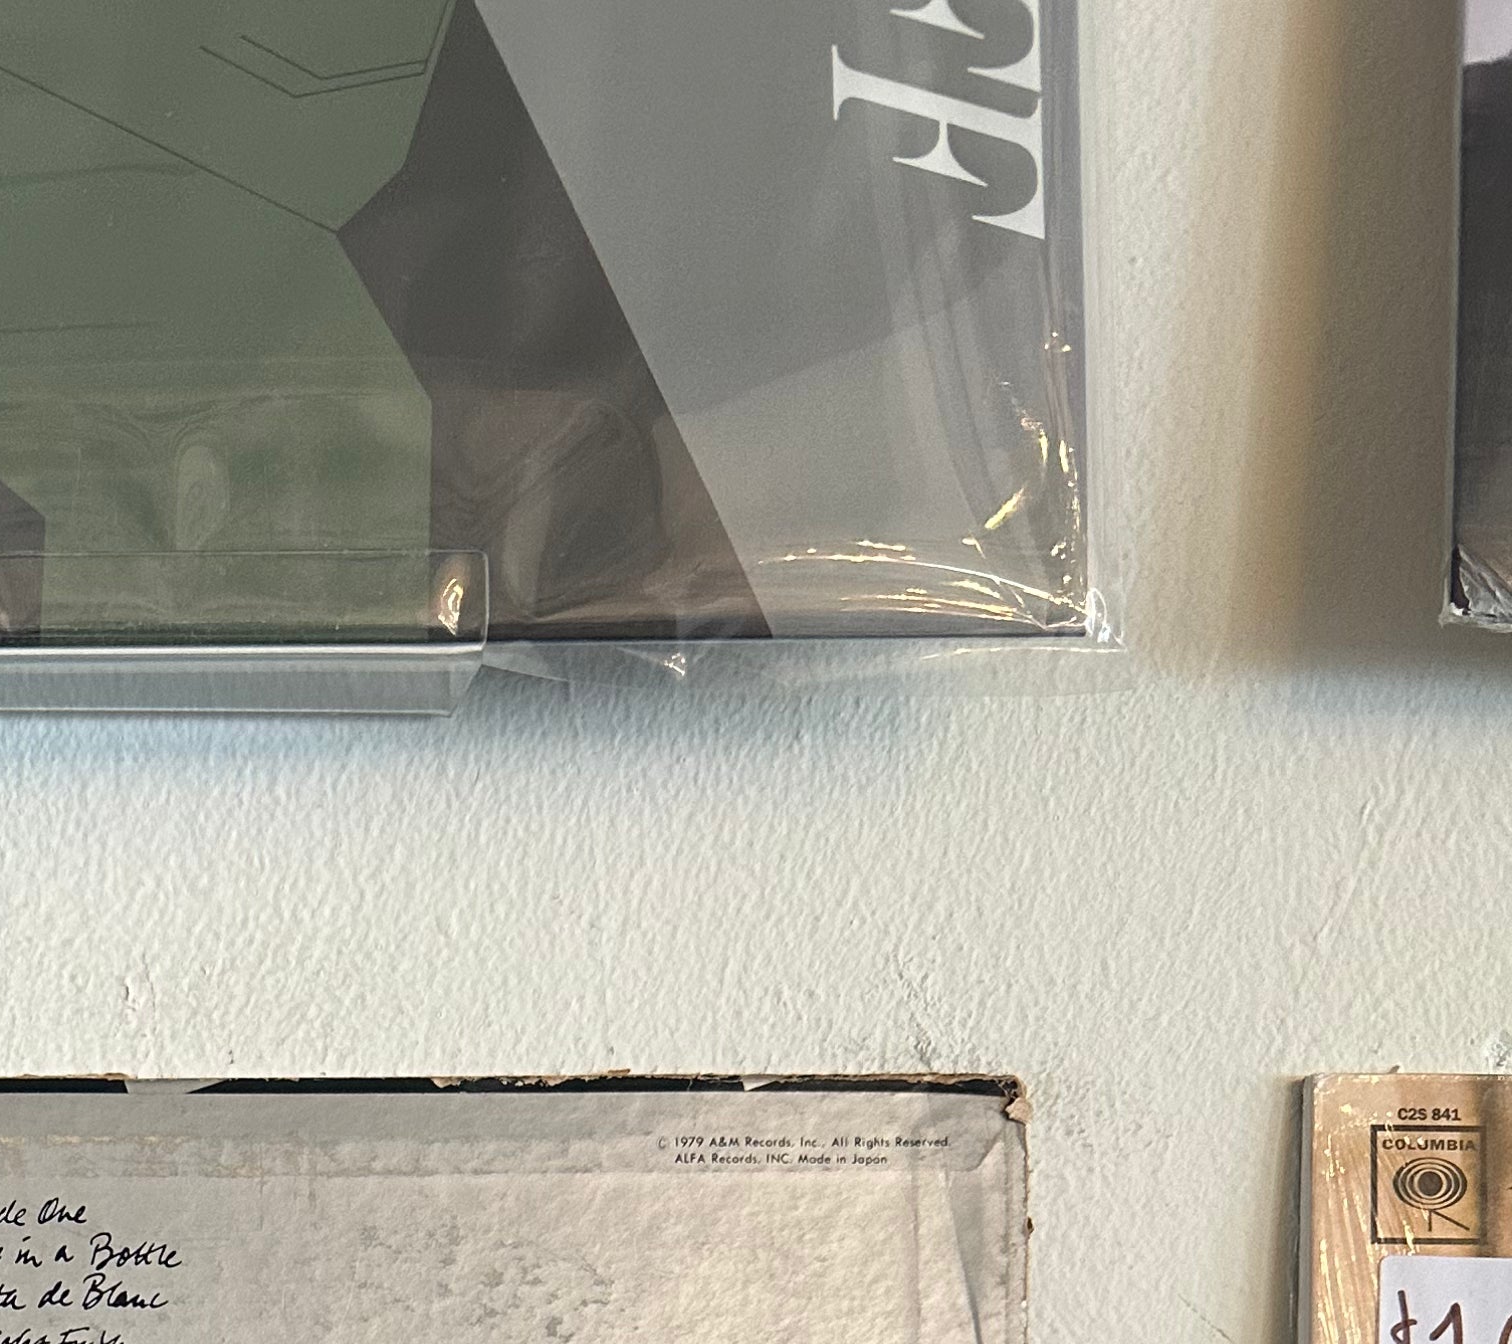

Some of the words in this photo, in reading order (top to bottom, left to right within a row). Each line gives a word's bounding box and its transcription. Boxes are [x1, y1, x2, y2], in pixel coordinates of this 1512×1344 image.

[1397, 1107, 1428, 1122] C2S
[1431, 1107, 1462, 1122] 841
[674, 1136, 704, 1148] 1979
[708, 1136, 739, 1148] A&M
[831, 1136, 849, 1148] All
[854, 1136, 890, 1150] Rights
[1381, 1138, 1477, 1152] COLUMBIA
[674, 1153, 705, 1164] ALFA
[798, 1153, 831, 1164] Made
[836, 1154, 847, 1164] in
[851, 1153, 888, 1166] Japan
[37, 1197, 88, 1225] One
[14, 1235, 43, 1268] in
[54, 1245, 75, 1263] a
[90, 1232, 183, 1270] Bottle
[37, 1281, 74, 1308] de
[83, 1272, 169, 1310] Blanc
